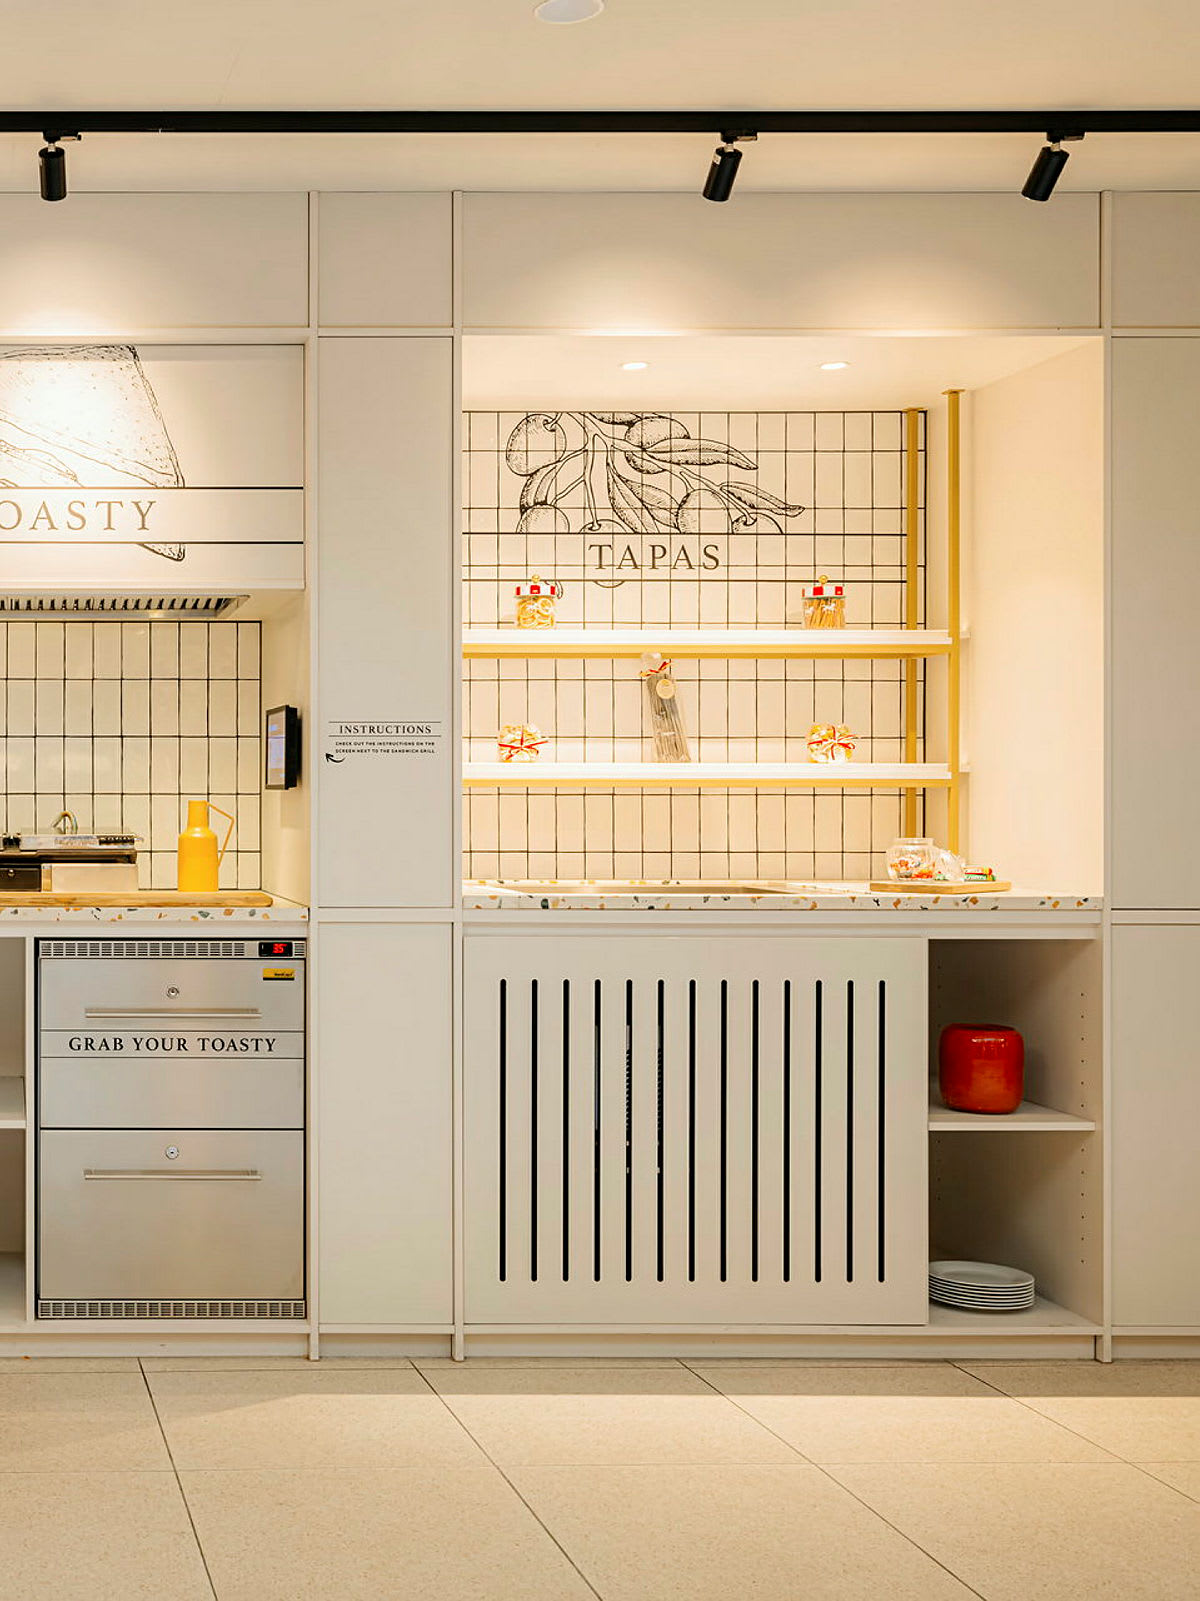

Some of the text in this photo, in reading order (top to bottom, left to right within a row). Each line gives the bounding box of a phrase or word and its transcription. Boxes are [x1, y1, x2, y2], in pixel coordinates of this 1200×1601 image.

[589, 544, 720, 571] TAPAS
[340, 725, 432, 734] INSTRUCTIONS
[69, 1037, 277, 1052] GRAB YOUR TOASTY
